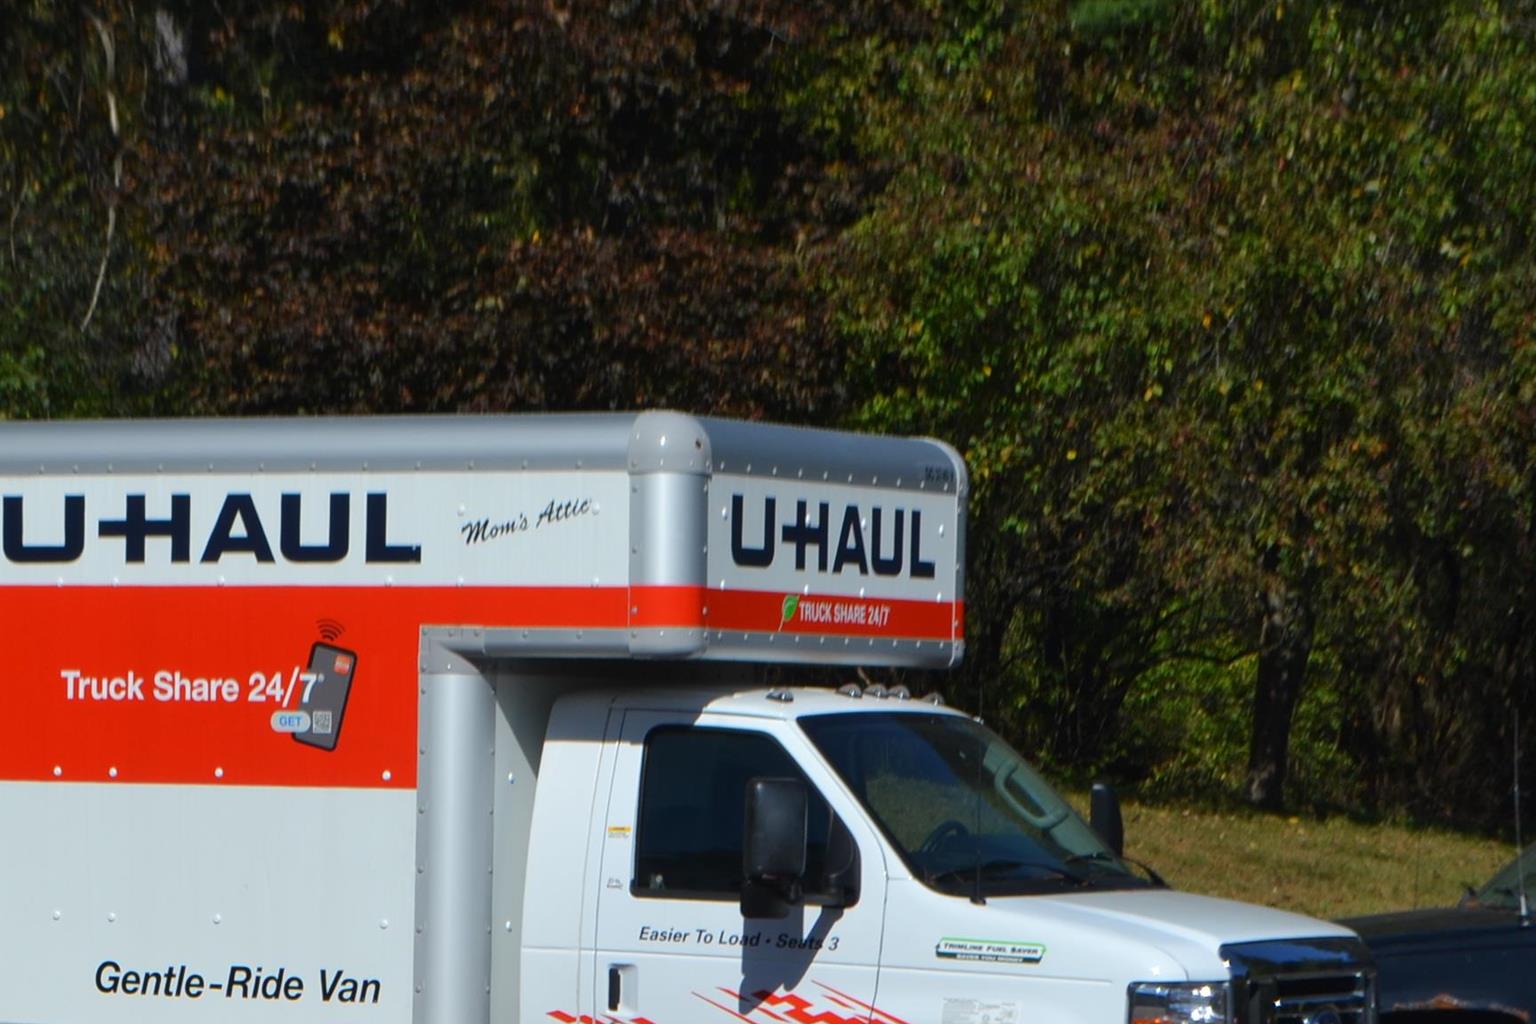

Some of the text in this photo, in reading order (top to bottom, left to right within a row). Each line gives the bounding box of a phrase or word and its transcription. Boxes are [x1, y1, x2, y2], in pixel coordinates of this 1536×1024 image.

[2, 492, 422, 564] U-HAUL
[461, 498, 592, 545] Mom's Attic
[731, 493, 936, 579] U-HAUL
[799, 601, 890, 628] TRUCK SHARE 24/7
[60, 669, 144, 701] Truck
[153, 669, 240, 702] Share
[279, 716, 302, 727] GET
[638, 926, 840, 951] Easier To Load Seats 3
[986, 945, 1008, 954] FUEL
[95, 960, 381, 1003] Gentle-Ride Van
